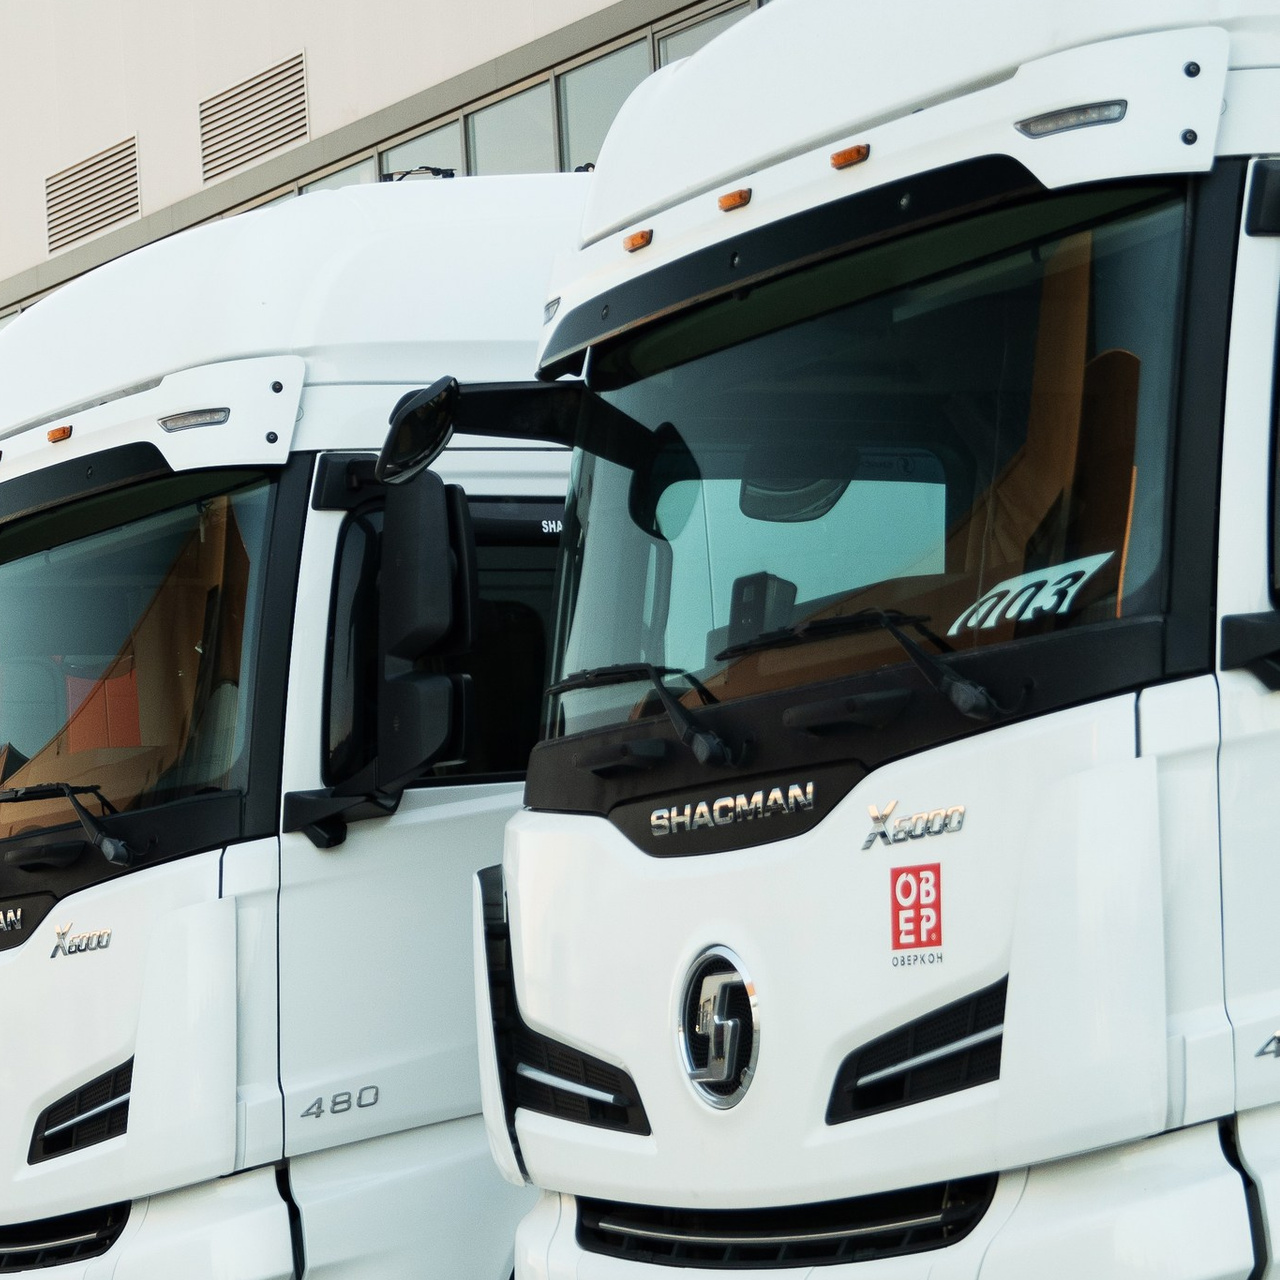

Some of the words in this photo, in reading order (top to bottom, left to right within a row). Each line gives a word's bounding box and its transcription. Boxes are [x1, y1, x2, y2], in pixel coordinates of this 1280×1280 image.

[956, 570, 1087, 629] 003
[650, 781, 815, 837] SHACMAN
[861, 799, 966, 851] X6000
[50, 922, 112, 959] X6000
[892, 952, 943, 968] ОВЕРКОН
[300, 1085, 379, 1118] 480
